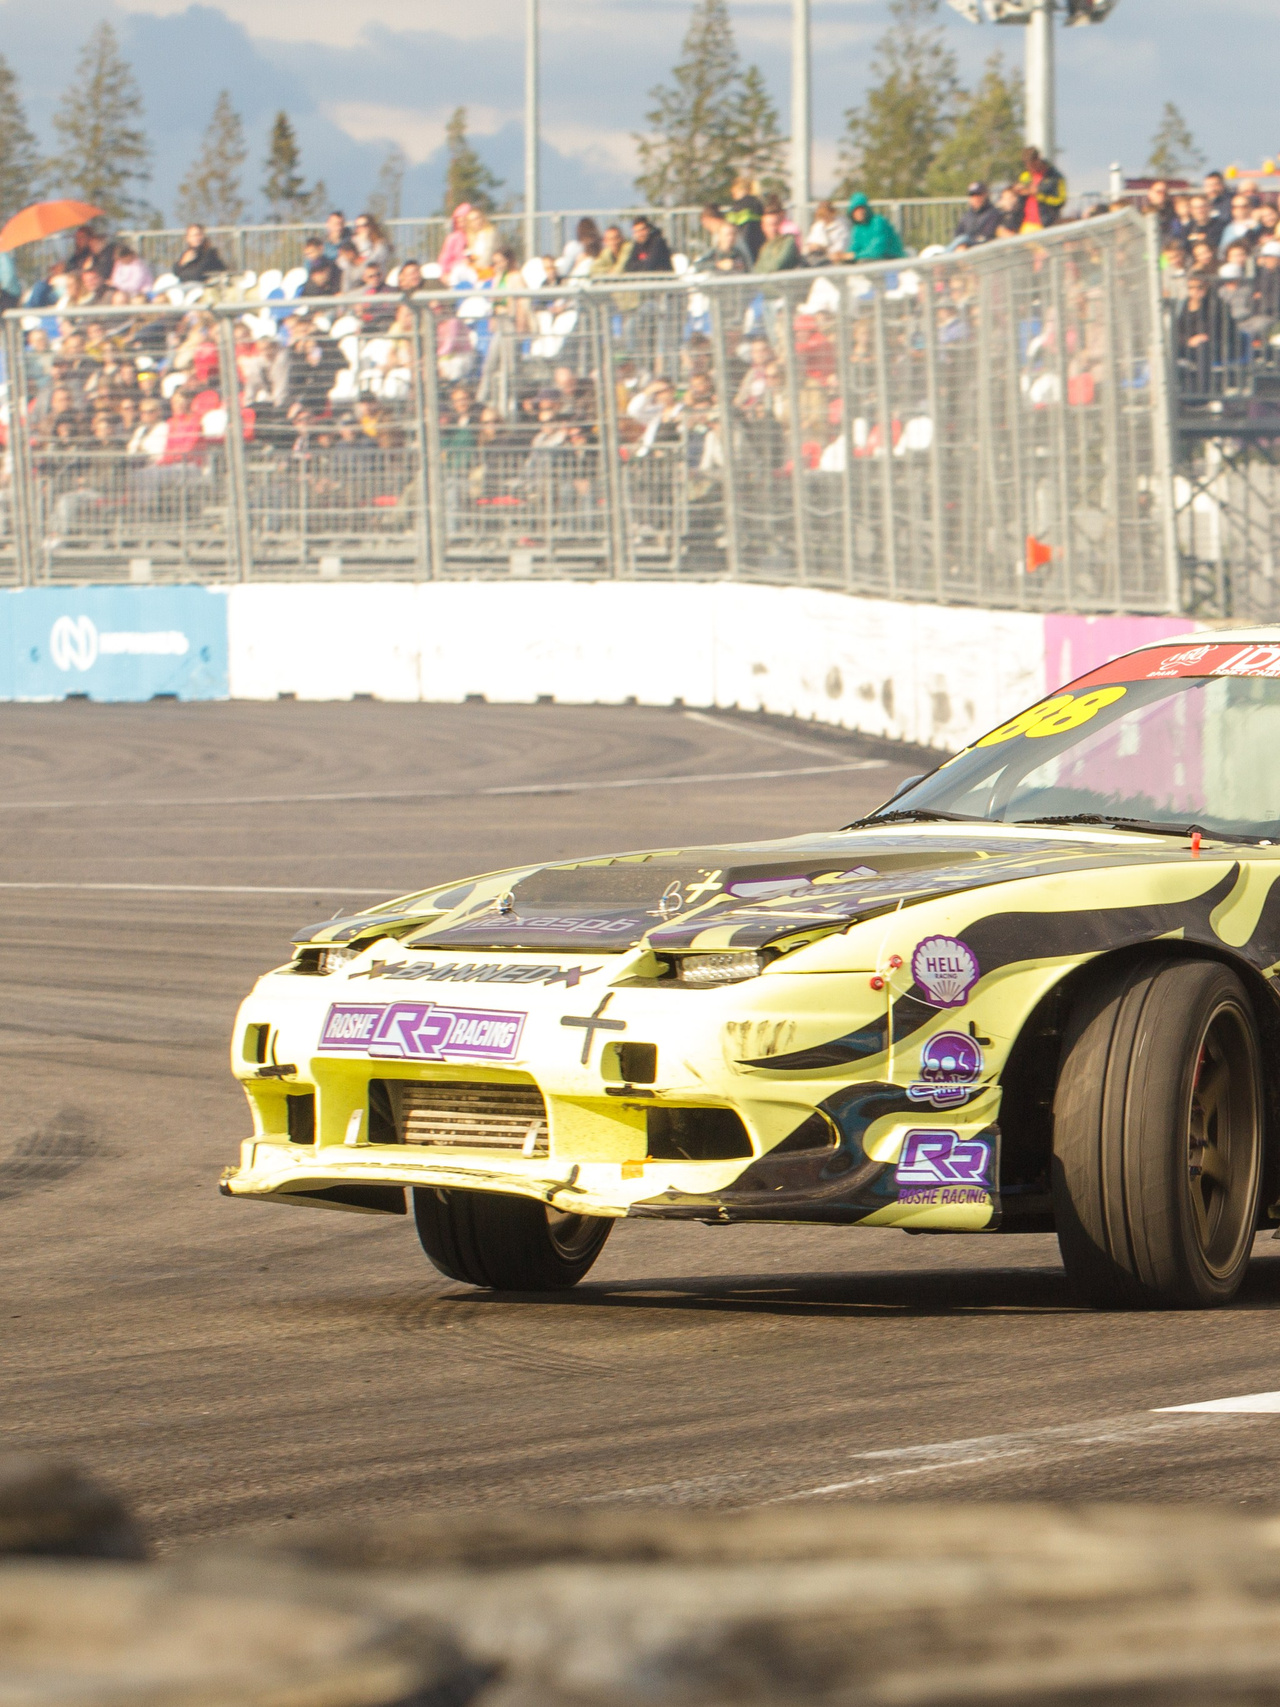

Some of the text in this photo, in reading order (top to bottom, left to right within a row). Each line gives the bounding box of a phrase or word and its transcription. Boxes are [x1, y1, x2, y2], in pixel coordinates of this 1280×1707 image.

[976, 686, 1127, 748] 88
[384, 961, 562, 983] BANNED
[926, 957, 964, 972] HELL
[326, 1013, 379, 1039] ROSHE
[449, 1018, 518, 1048] RACING
[898, 1189, 988, 1205] ROSHE RACING
